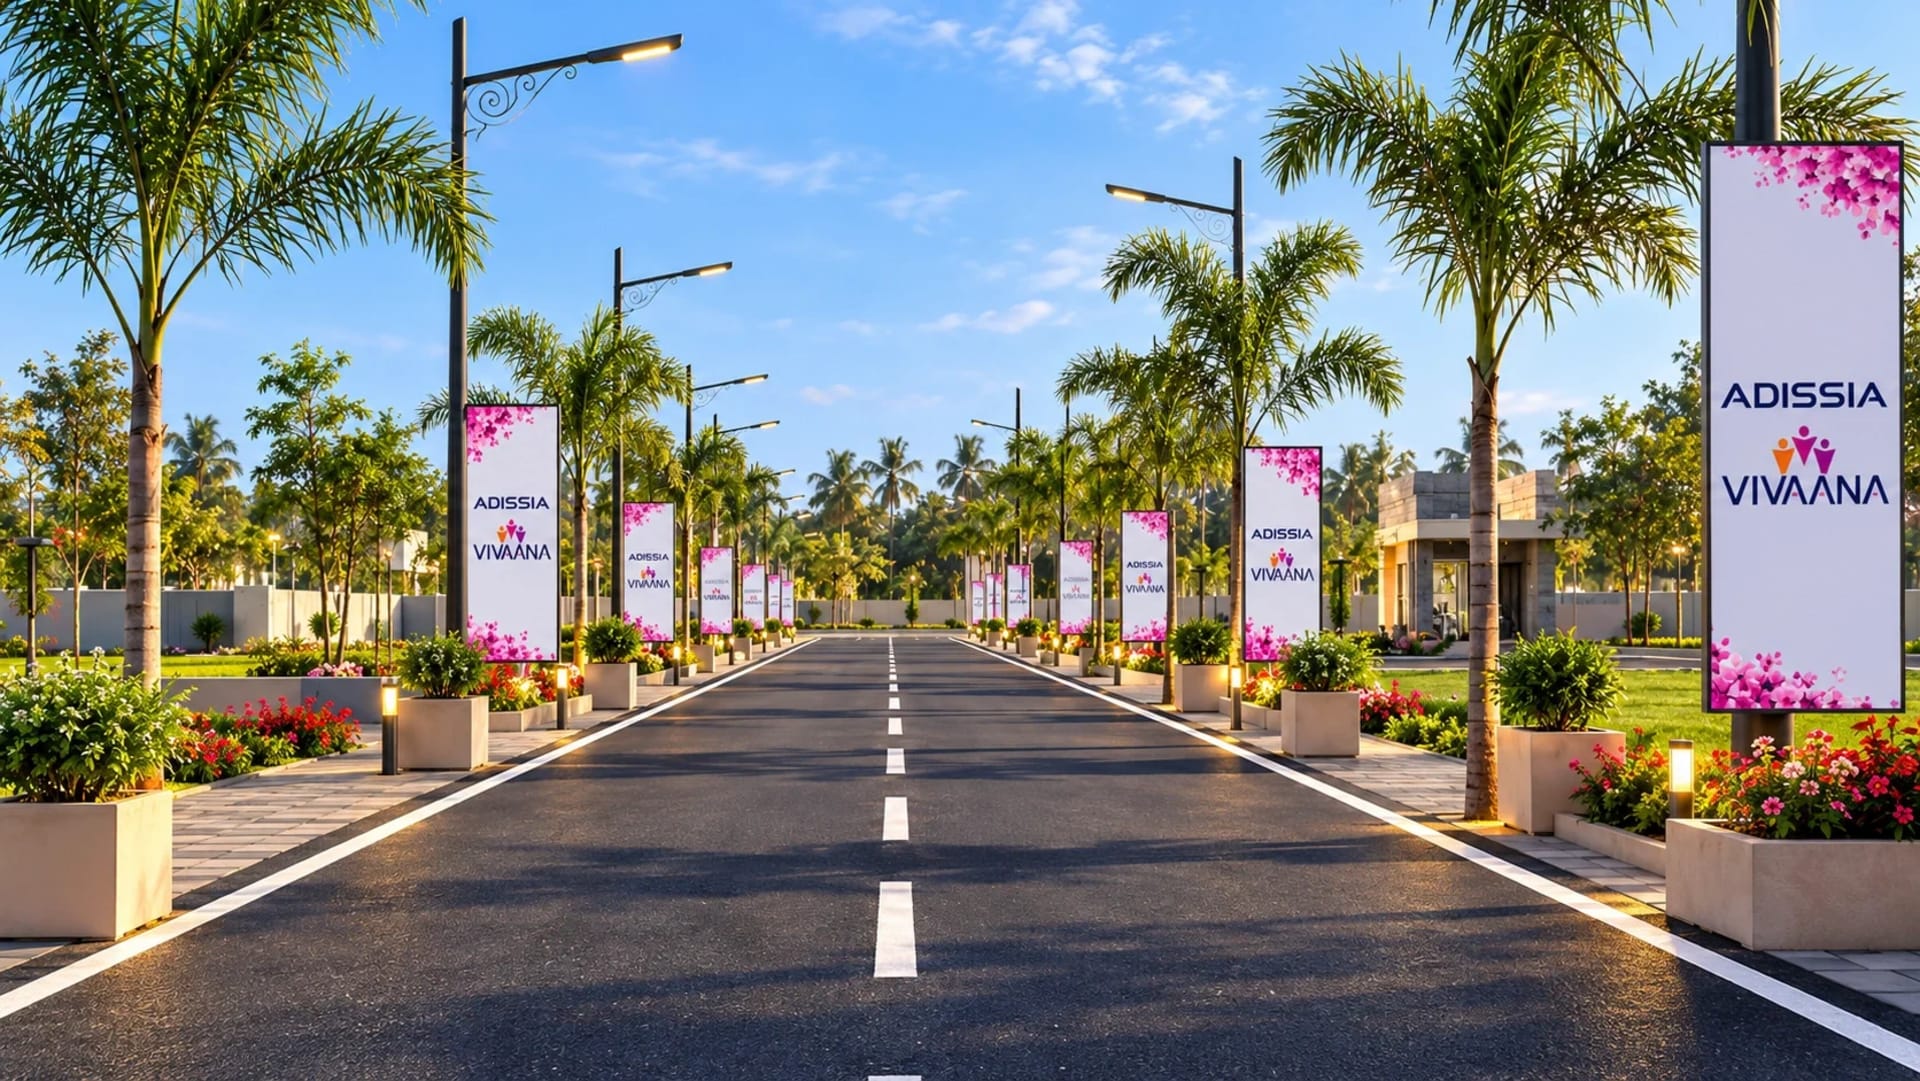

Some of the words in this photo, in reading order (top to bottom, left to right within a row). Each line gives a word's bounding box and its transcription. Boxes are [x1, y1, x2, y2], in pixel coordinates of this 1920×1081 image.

[1721, 382, 1888, 409] ADISSIA
[1722, 475, 1889, 505] VIVAANA
[474, 496, 550, 510] ADISSIA
[1251, 528, 1313, 540] ADISSIA
[474, 544, 551, 560] VIVAANA
[628, 553, 669, 561] ADISSIA
[1251, 568, 1315, 582] VIVAANA
[627, 579, 671, 588] VIVAANA
[1126, 585, 1165, 593] VIVAANA
